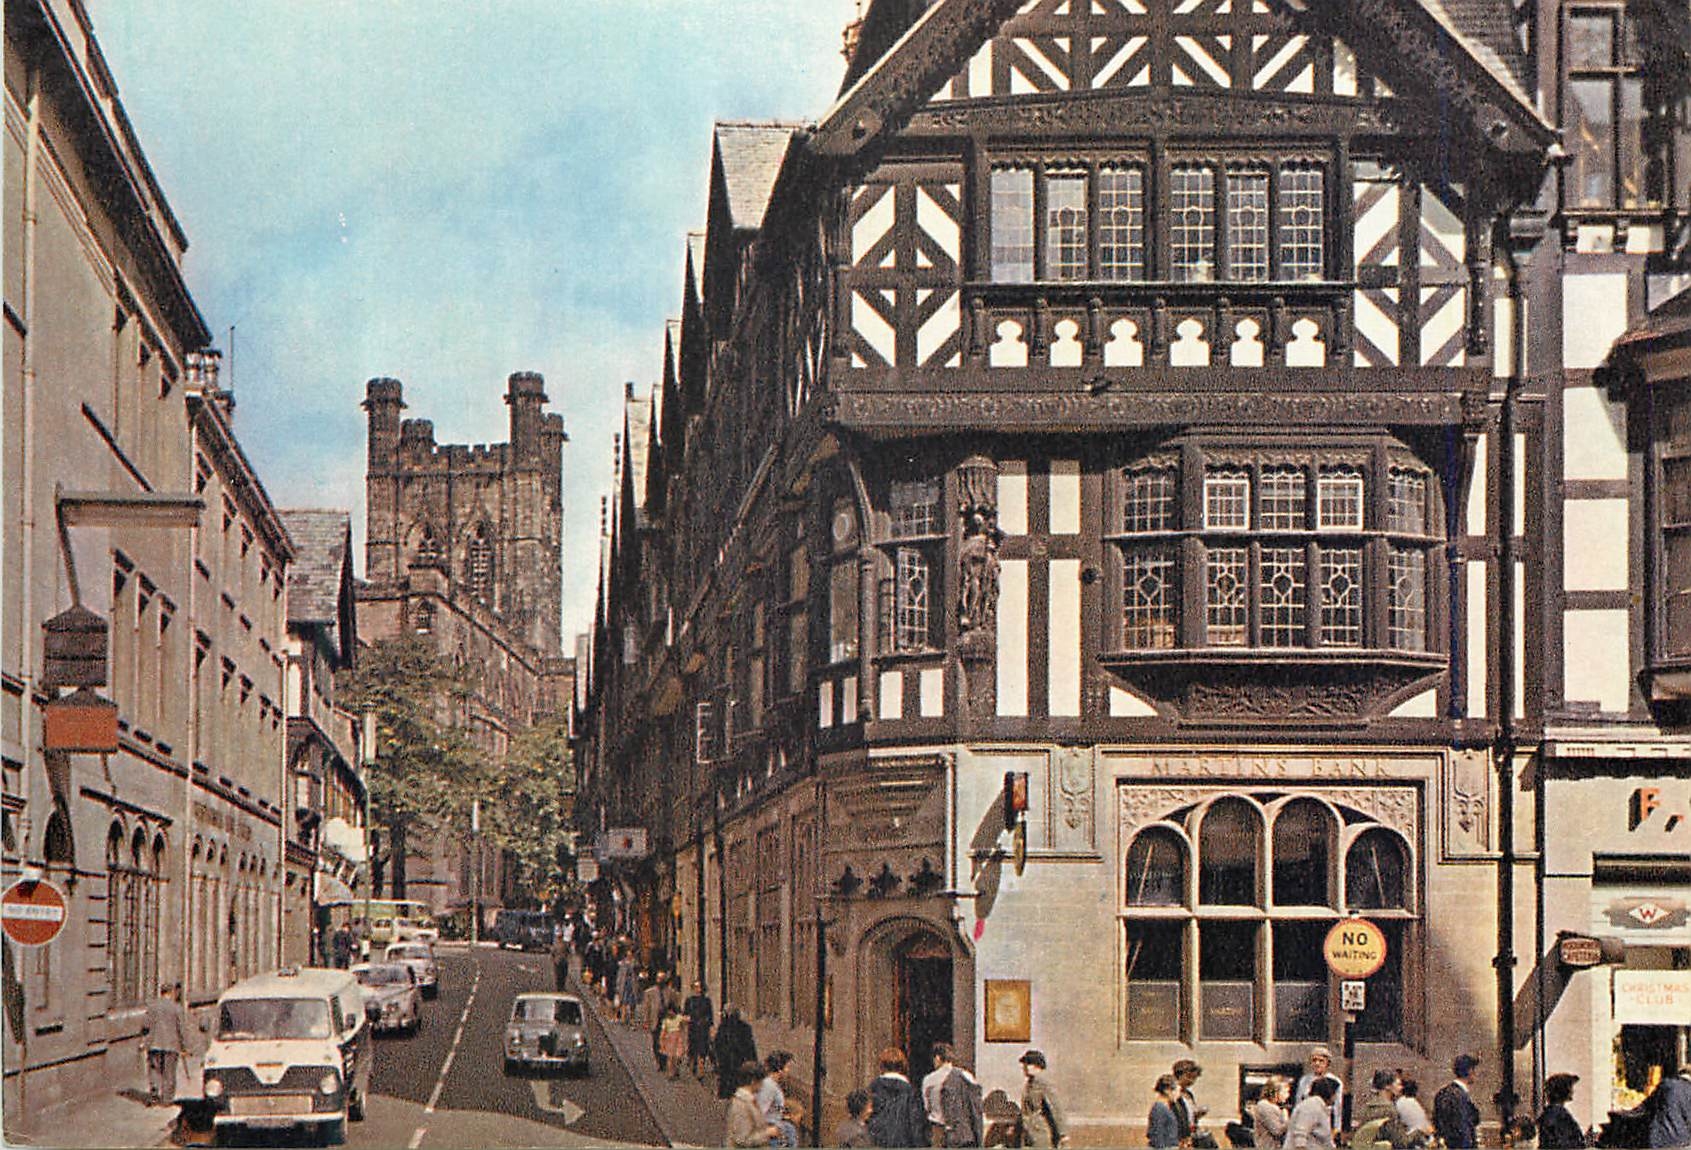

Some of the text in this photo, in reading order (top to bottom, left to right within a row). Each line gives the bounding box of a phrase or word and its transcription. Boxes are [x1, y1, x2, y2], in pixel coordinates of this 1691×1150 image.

[1151, 757, 1392, 778] MARTINS BANK
[1342, 932, 1368, 946] NO
[1332, 950, 1378, 960] WAITING
[1636, 993, 1674, 1005] CLUB
